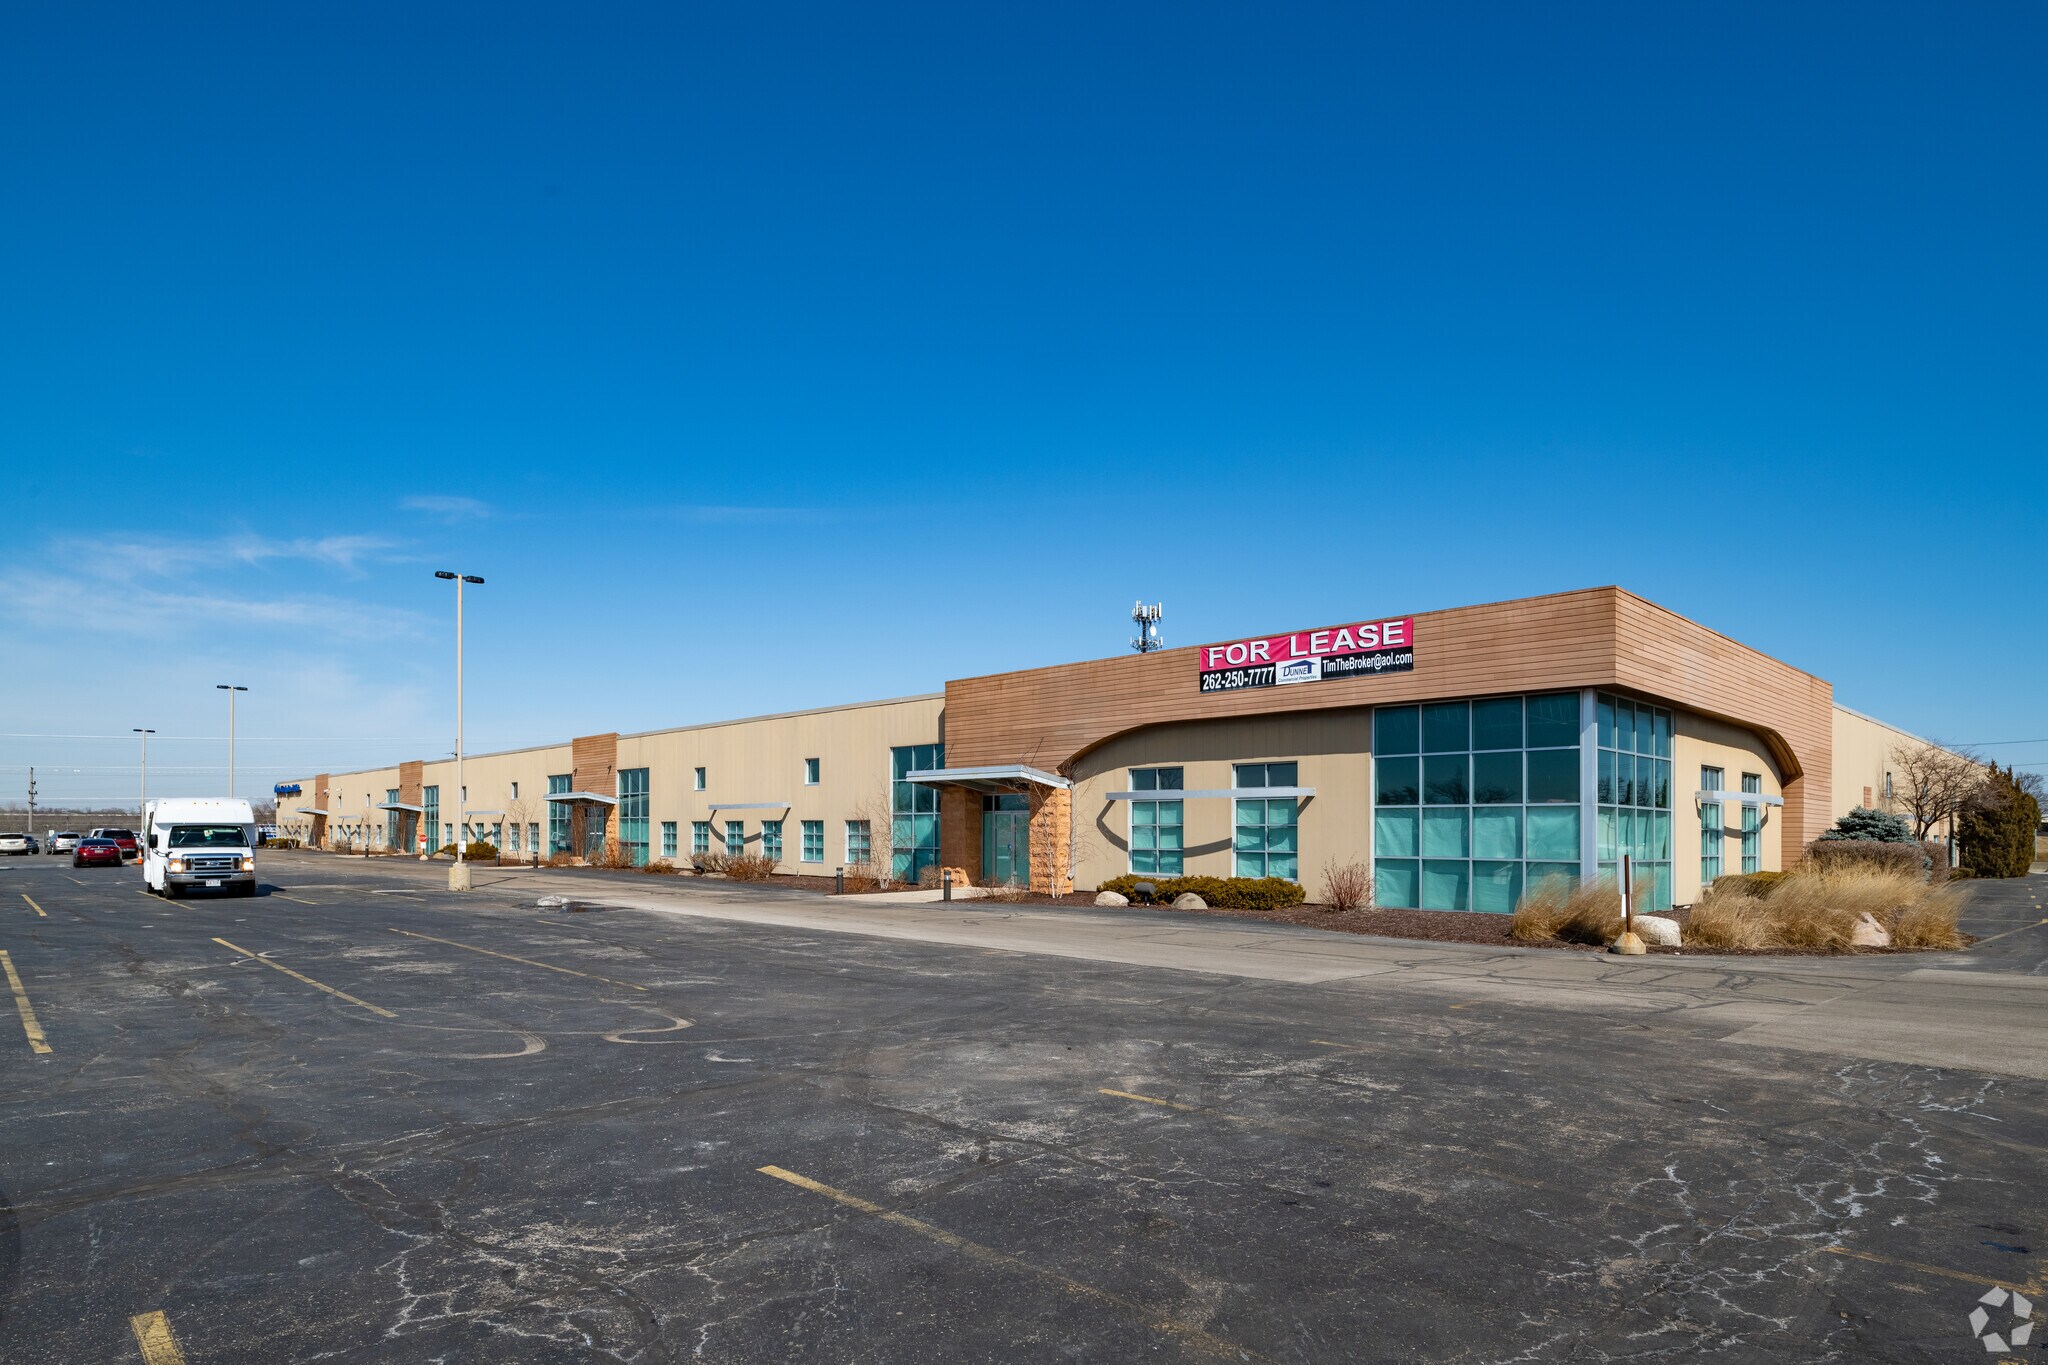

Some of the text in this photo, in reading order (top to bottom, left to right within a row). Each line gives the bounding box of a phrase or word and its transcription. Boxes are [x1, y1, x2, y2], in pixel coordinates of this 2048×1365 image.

[1208, 620, 1405, 668] FOR LEASE
[1283, 666, 1307, 676] DUNNE
[1322, 652, 1413, 673] TimTheBroker@aol.com
[1202, 666, 1275, 691] 262-250-7777
